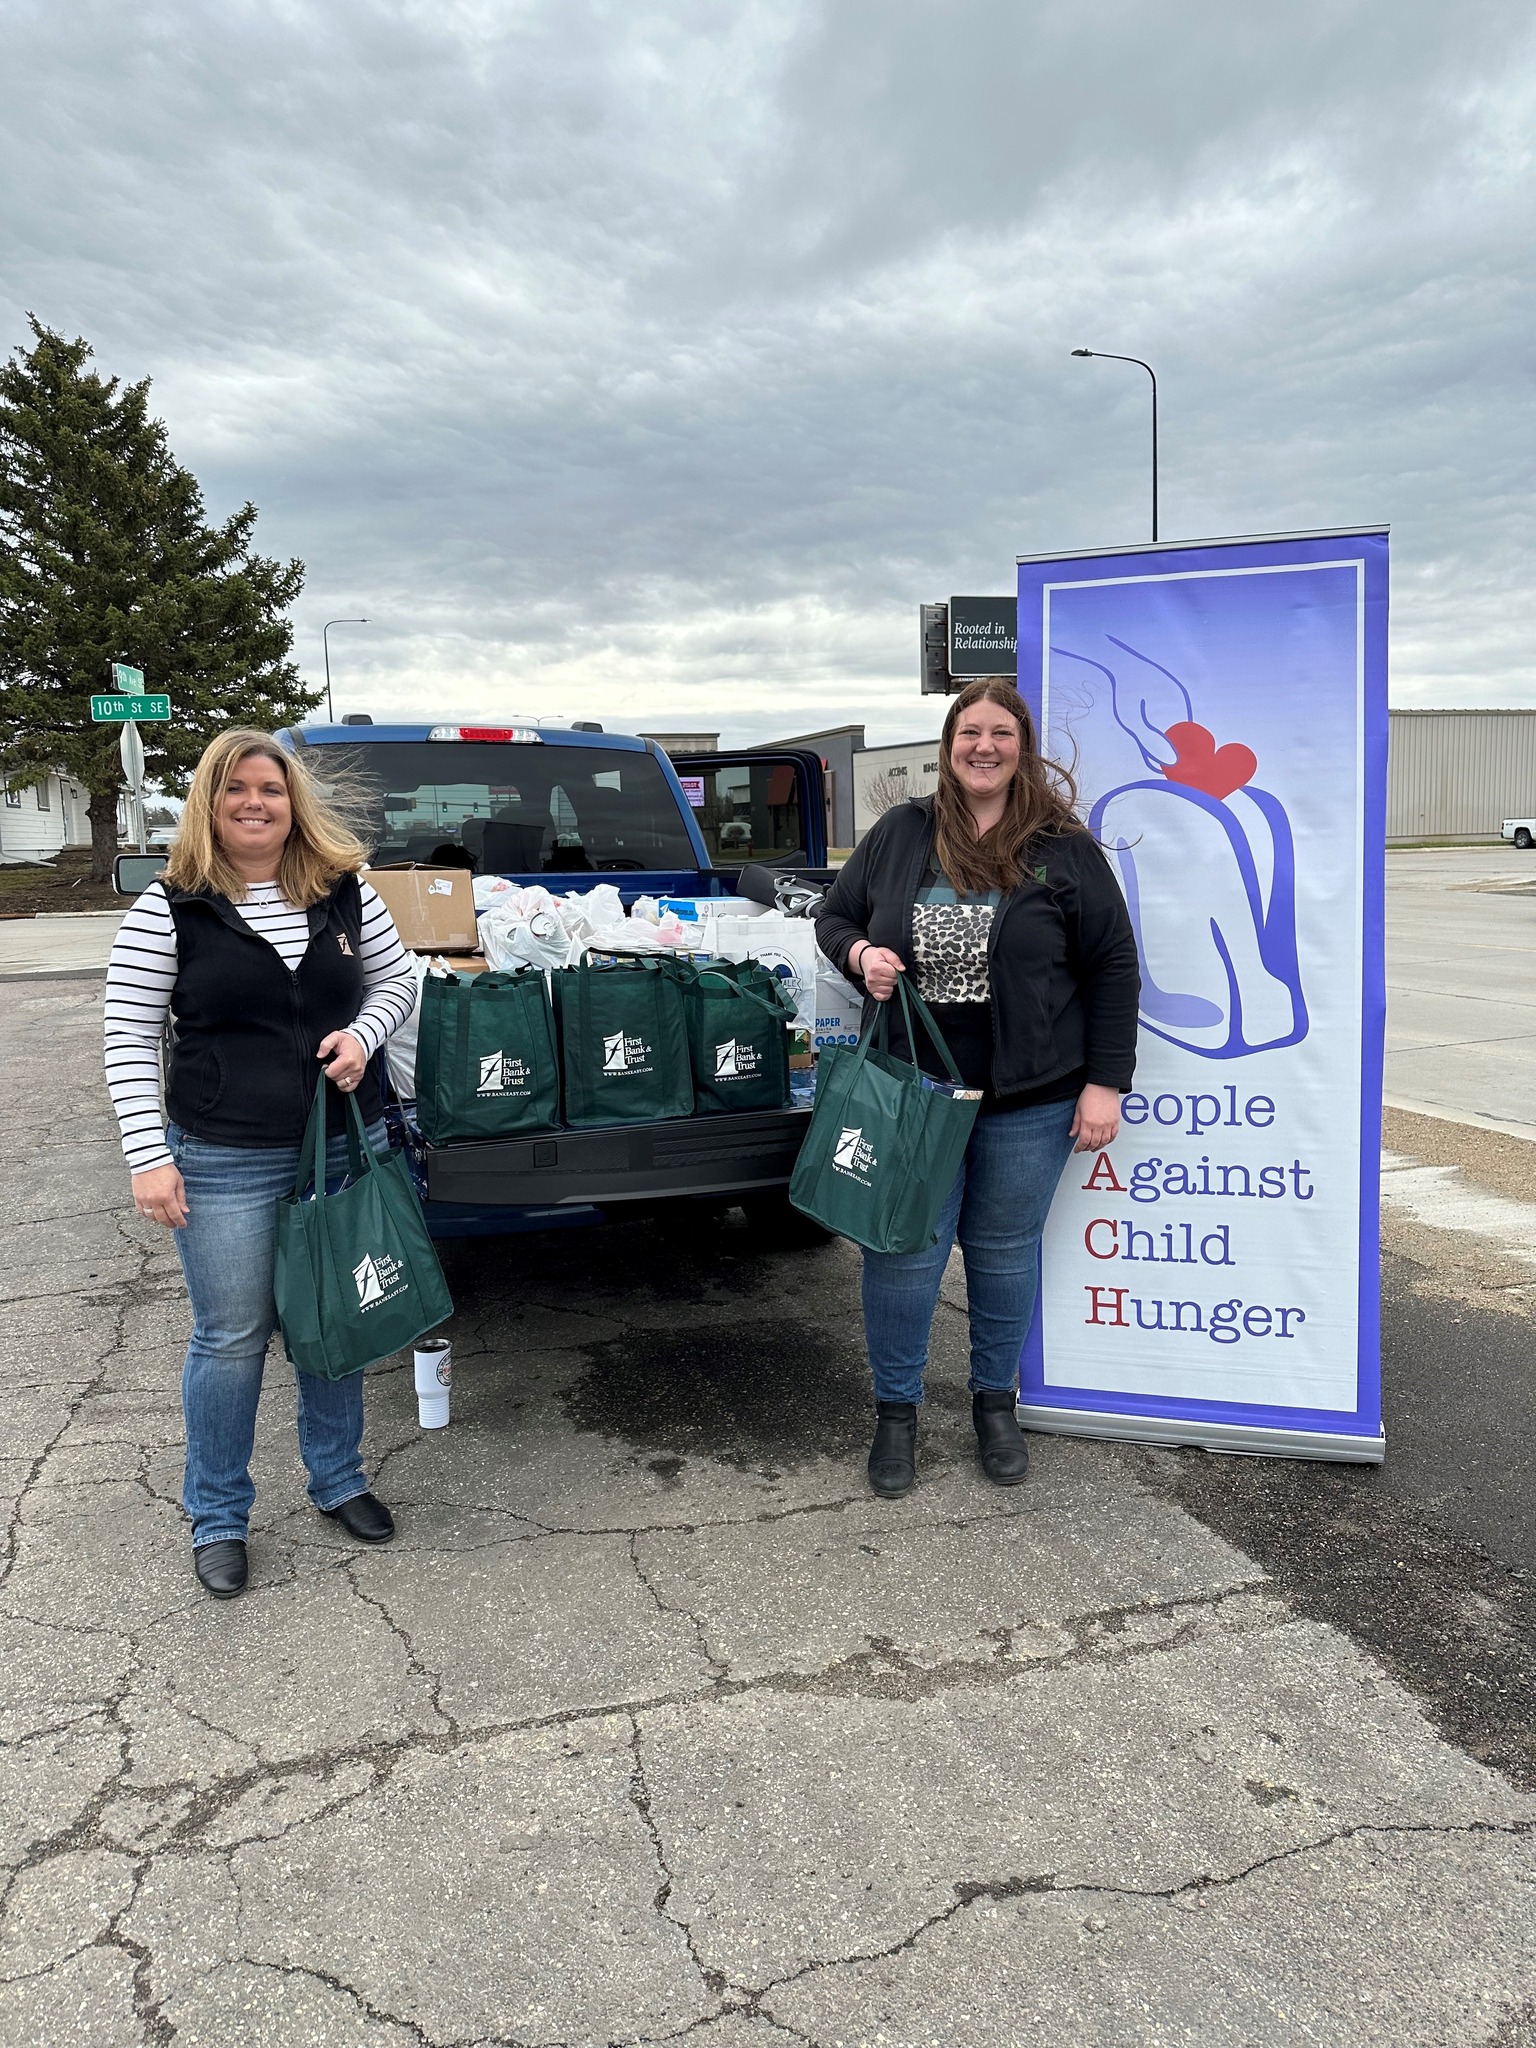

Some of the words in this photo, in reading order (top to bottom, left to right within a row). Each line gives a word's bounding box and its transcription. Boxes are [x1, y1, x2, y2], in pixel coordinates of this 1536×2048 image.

[954, 622, 991, 635] Rooted
[995, 622, 1005, 635] in
[97, 701, 124, 715] 10th
[131, 702, 142, 713] St
[150, 702, 164, 713] SE
[815, 1017, 841, 1028] PAPER
[624, 1037, 642, 1046] First
[625, 1045, 645, 1056] Bank
[736, 1045, 753, 1053] First
[503, 1058, 522, 1067] First
[625, 1055, 645, 1064] Trust
[736, 1052, 756, 1061] Bank
[503, 1067, 525, 1077] Bank
[525, 1067, 531, 1075] &
[736, 1062, 756, 1070] Trust
[502, 1076, 524, 1085] Trust
[1120, 1085, 1276, 1135] eople
[858, 1137, 874, 1152] First
[854, 1146, 873, 1164] Bank
[871, 1158, 877, 1166] &
[852, 1155, 869, 1172] Trust
[1081, 1151, 1314, 1203] Against
[1084, 1218, 1236, 1265] Child
[373, 1253, 392, 1270] First
[377, 1262, 398, 1280] Bank
[397, 1259, 404, 1268] &
[380, 1272, 400, 1289] Trust
[1084, 1285, 1306, 1344] Hunger
